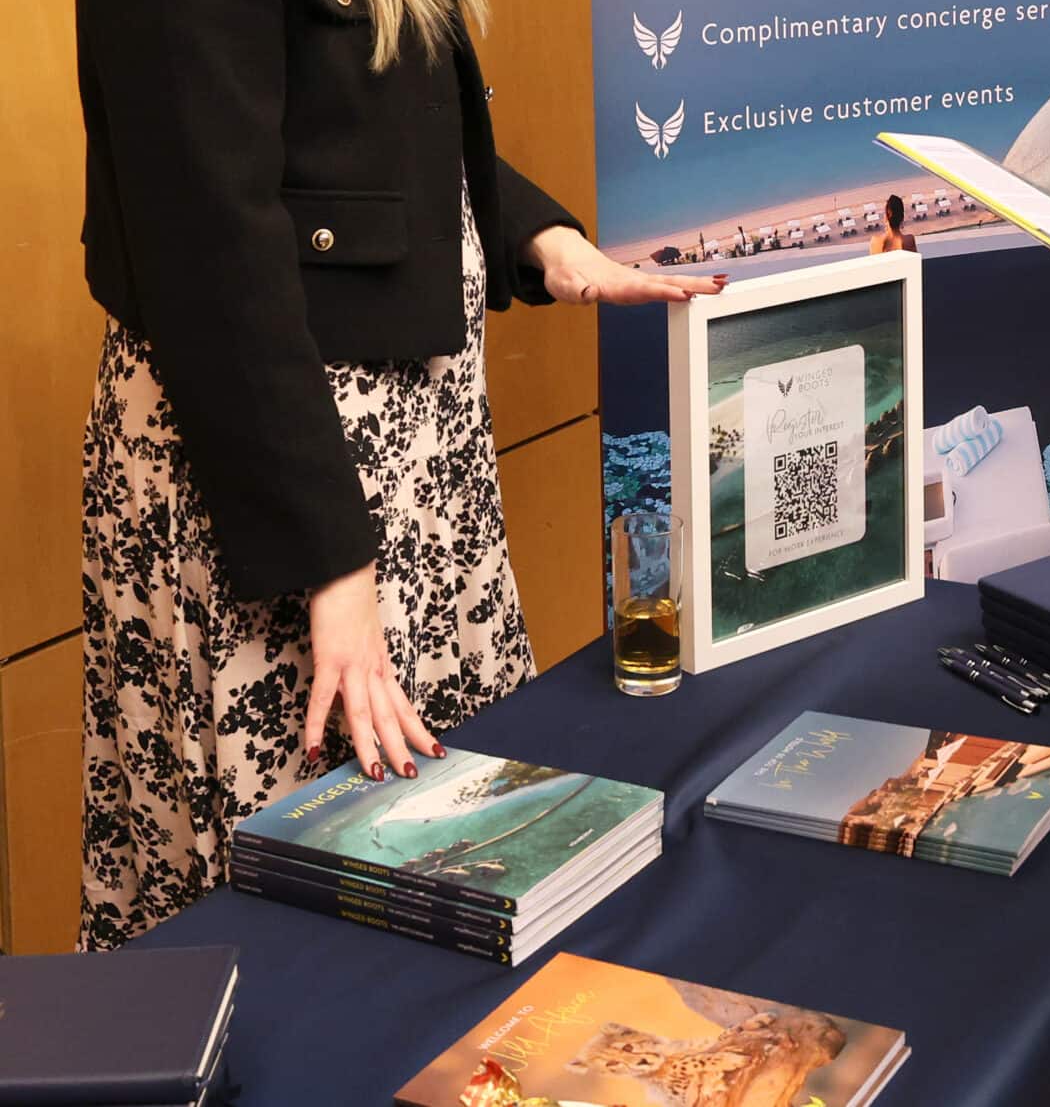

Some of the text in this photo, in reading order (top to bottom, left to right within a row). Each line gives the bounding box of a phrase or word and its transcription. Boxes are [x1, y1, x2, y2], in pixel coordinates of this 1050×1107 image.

[702, 14, 886, 48] Complimentary
[897, 5, 1006, 30] concierge
[704, 85, 1014, 134] Exclusive customer events
[797, 368, 832, 383] WINGED
[517, 1005, 535, 1016] TO
